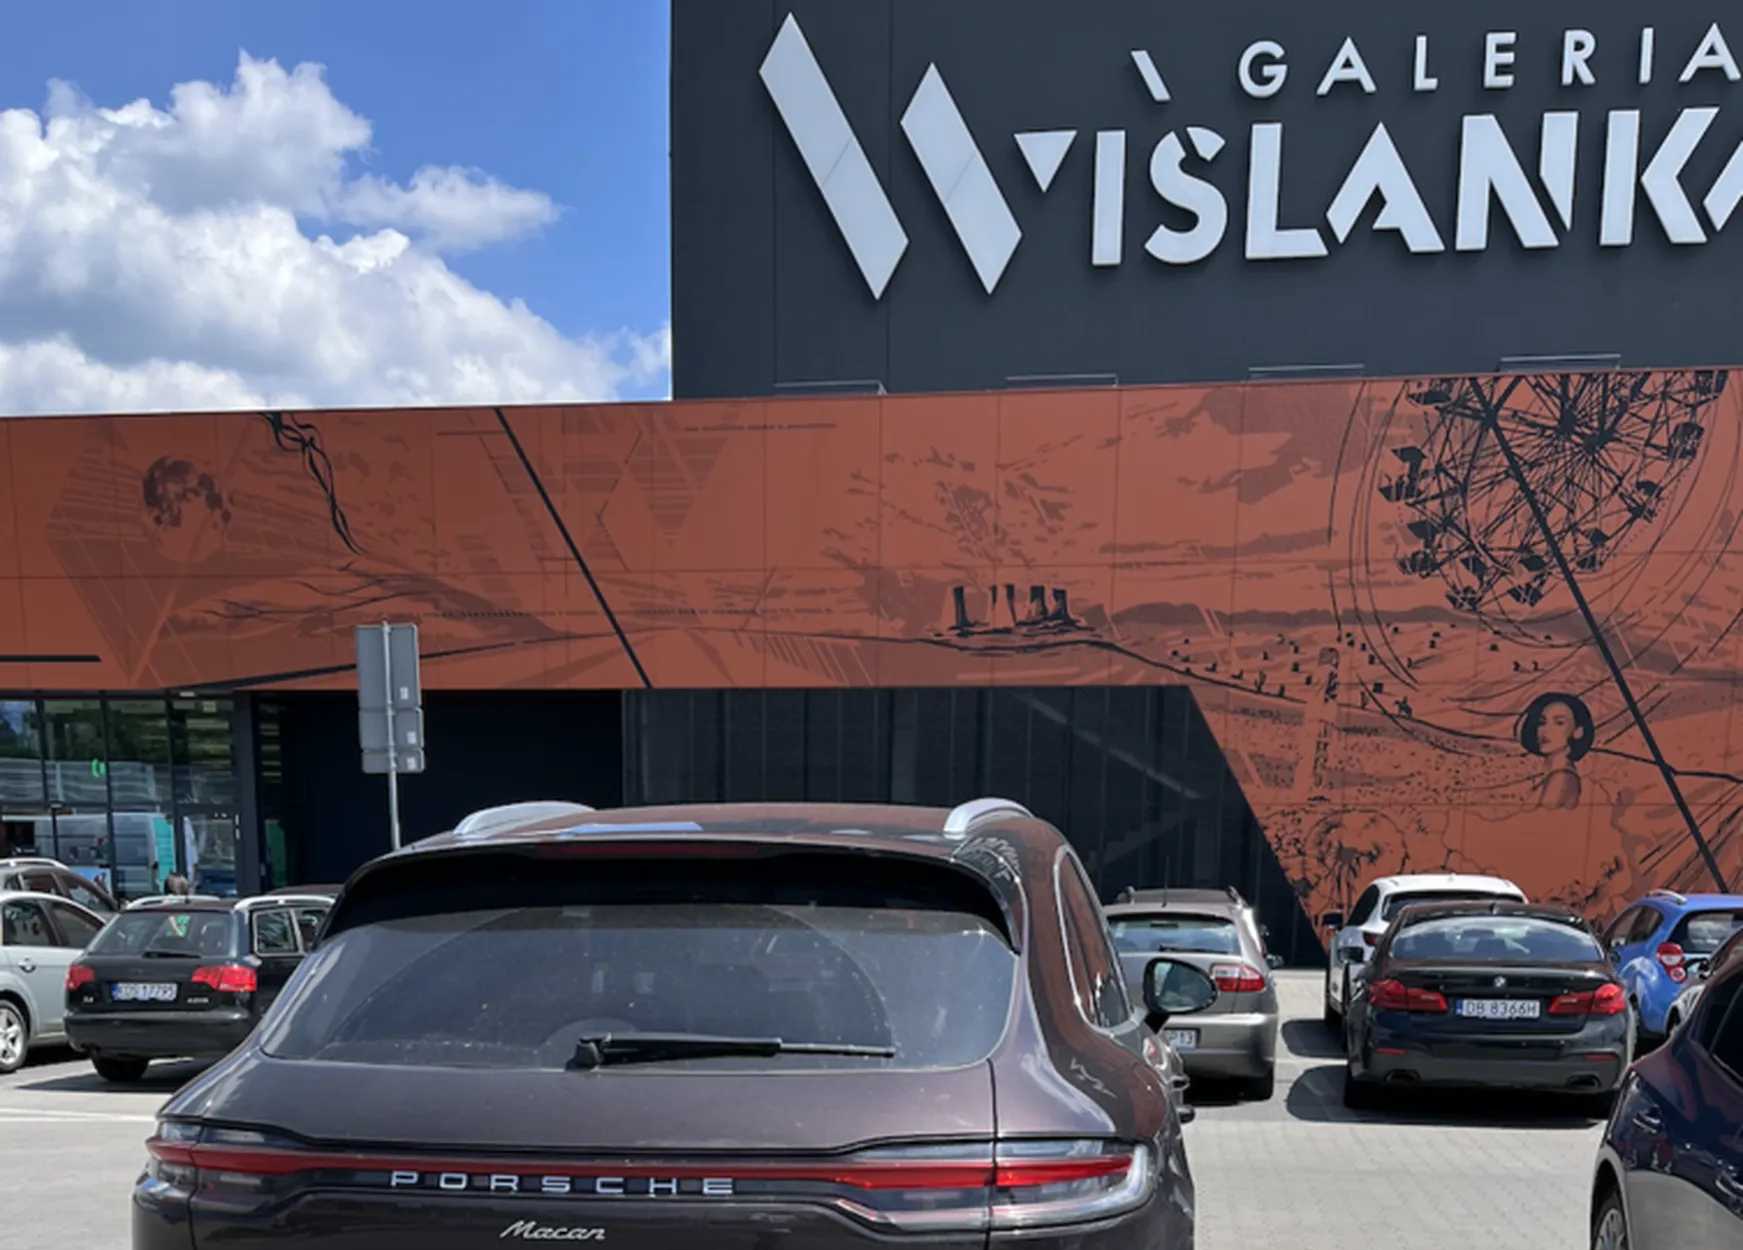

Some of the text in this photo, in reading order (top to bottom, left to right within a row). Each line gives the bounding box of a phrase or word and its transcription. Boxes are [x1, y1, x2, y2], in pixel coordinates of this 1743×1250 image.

[1237, 22, 1742, 98] GALERIA
[389, 1170, 734, 1195] PORSCHE
[499, 1219, 607, 1240] Macan
